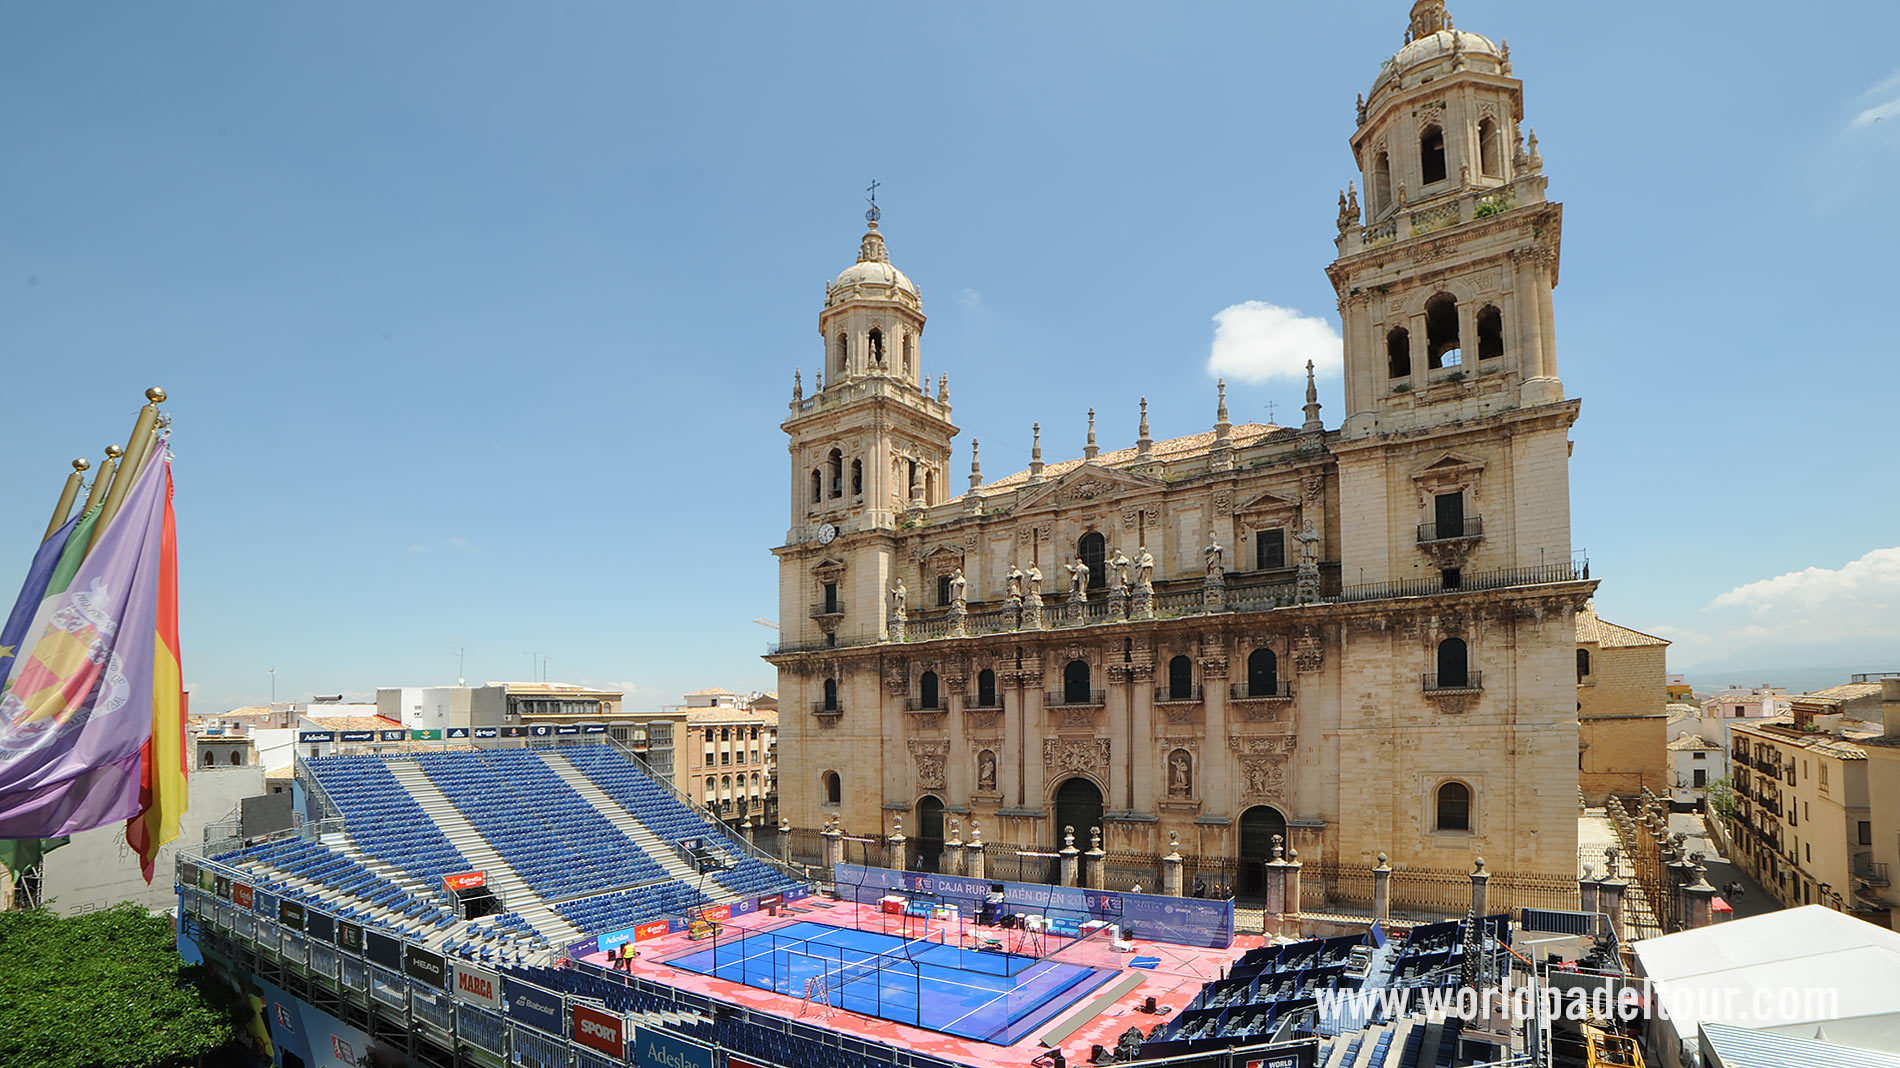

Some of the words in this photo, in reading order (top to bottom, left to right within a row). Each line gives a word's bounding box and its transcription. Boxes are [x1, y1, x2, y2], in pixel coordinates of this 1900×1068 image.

[938, 881, 964, 893] CAJA
[965, 884, 993, 896] RURA
[1005, 887, 1033, 900] JAÉN
[1035, 892, 1065, 904] OPEN
[413, 957, 439, 974] HEAD
[459, 972, 493, 1000] MARCA
[580, 1019, 617, 1044] SPORT
[1268, 1059, 1293, 1068] WORLD
